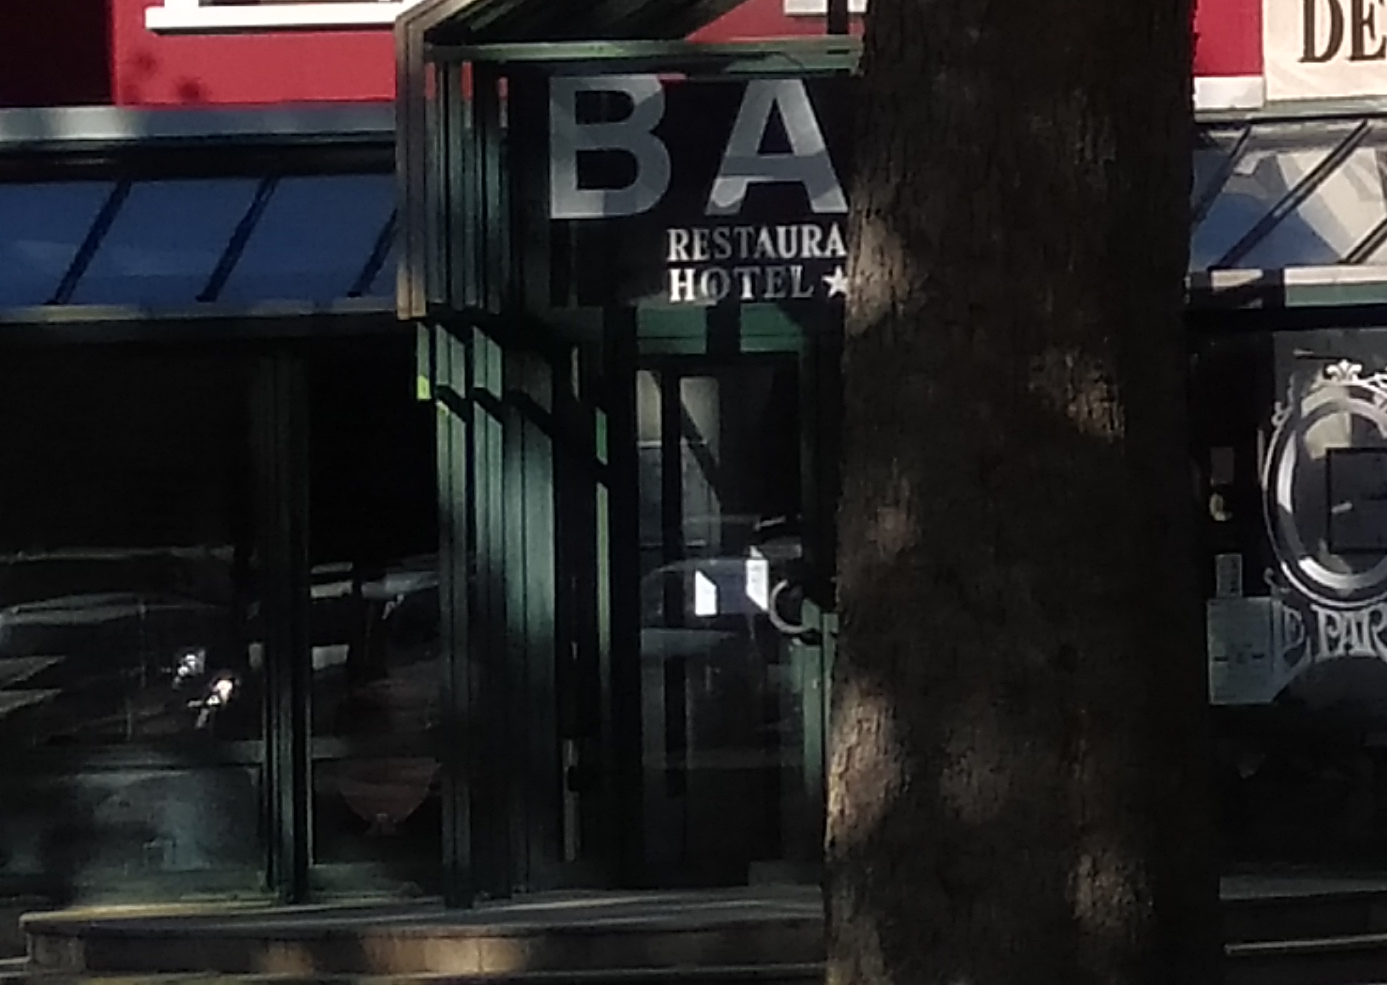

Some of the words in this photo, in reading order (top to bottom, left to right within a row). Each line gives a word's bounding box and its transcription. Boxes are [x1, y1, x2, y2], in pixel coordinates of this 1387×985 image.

[550, 73, 848, 219] BA
[667, 222, 847, 262] RESTAURA
[668, 265, 815, 303] HOTEL
